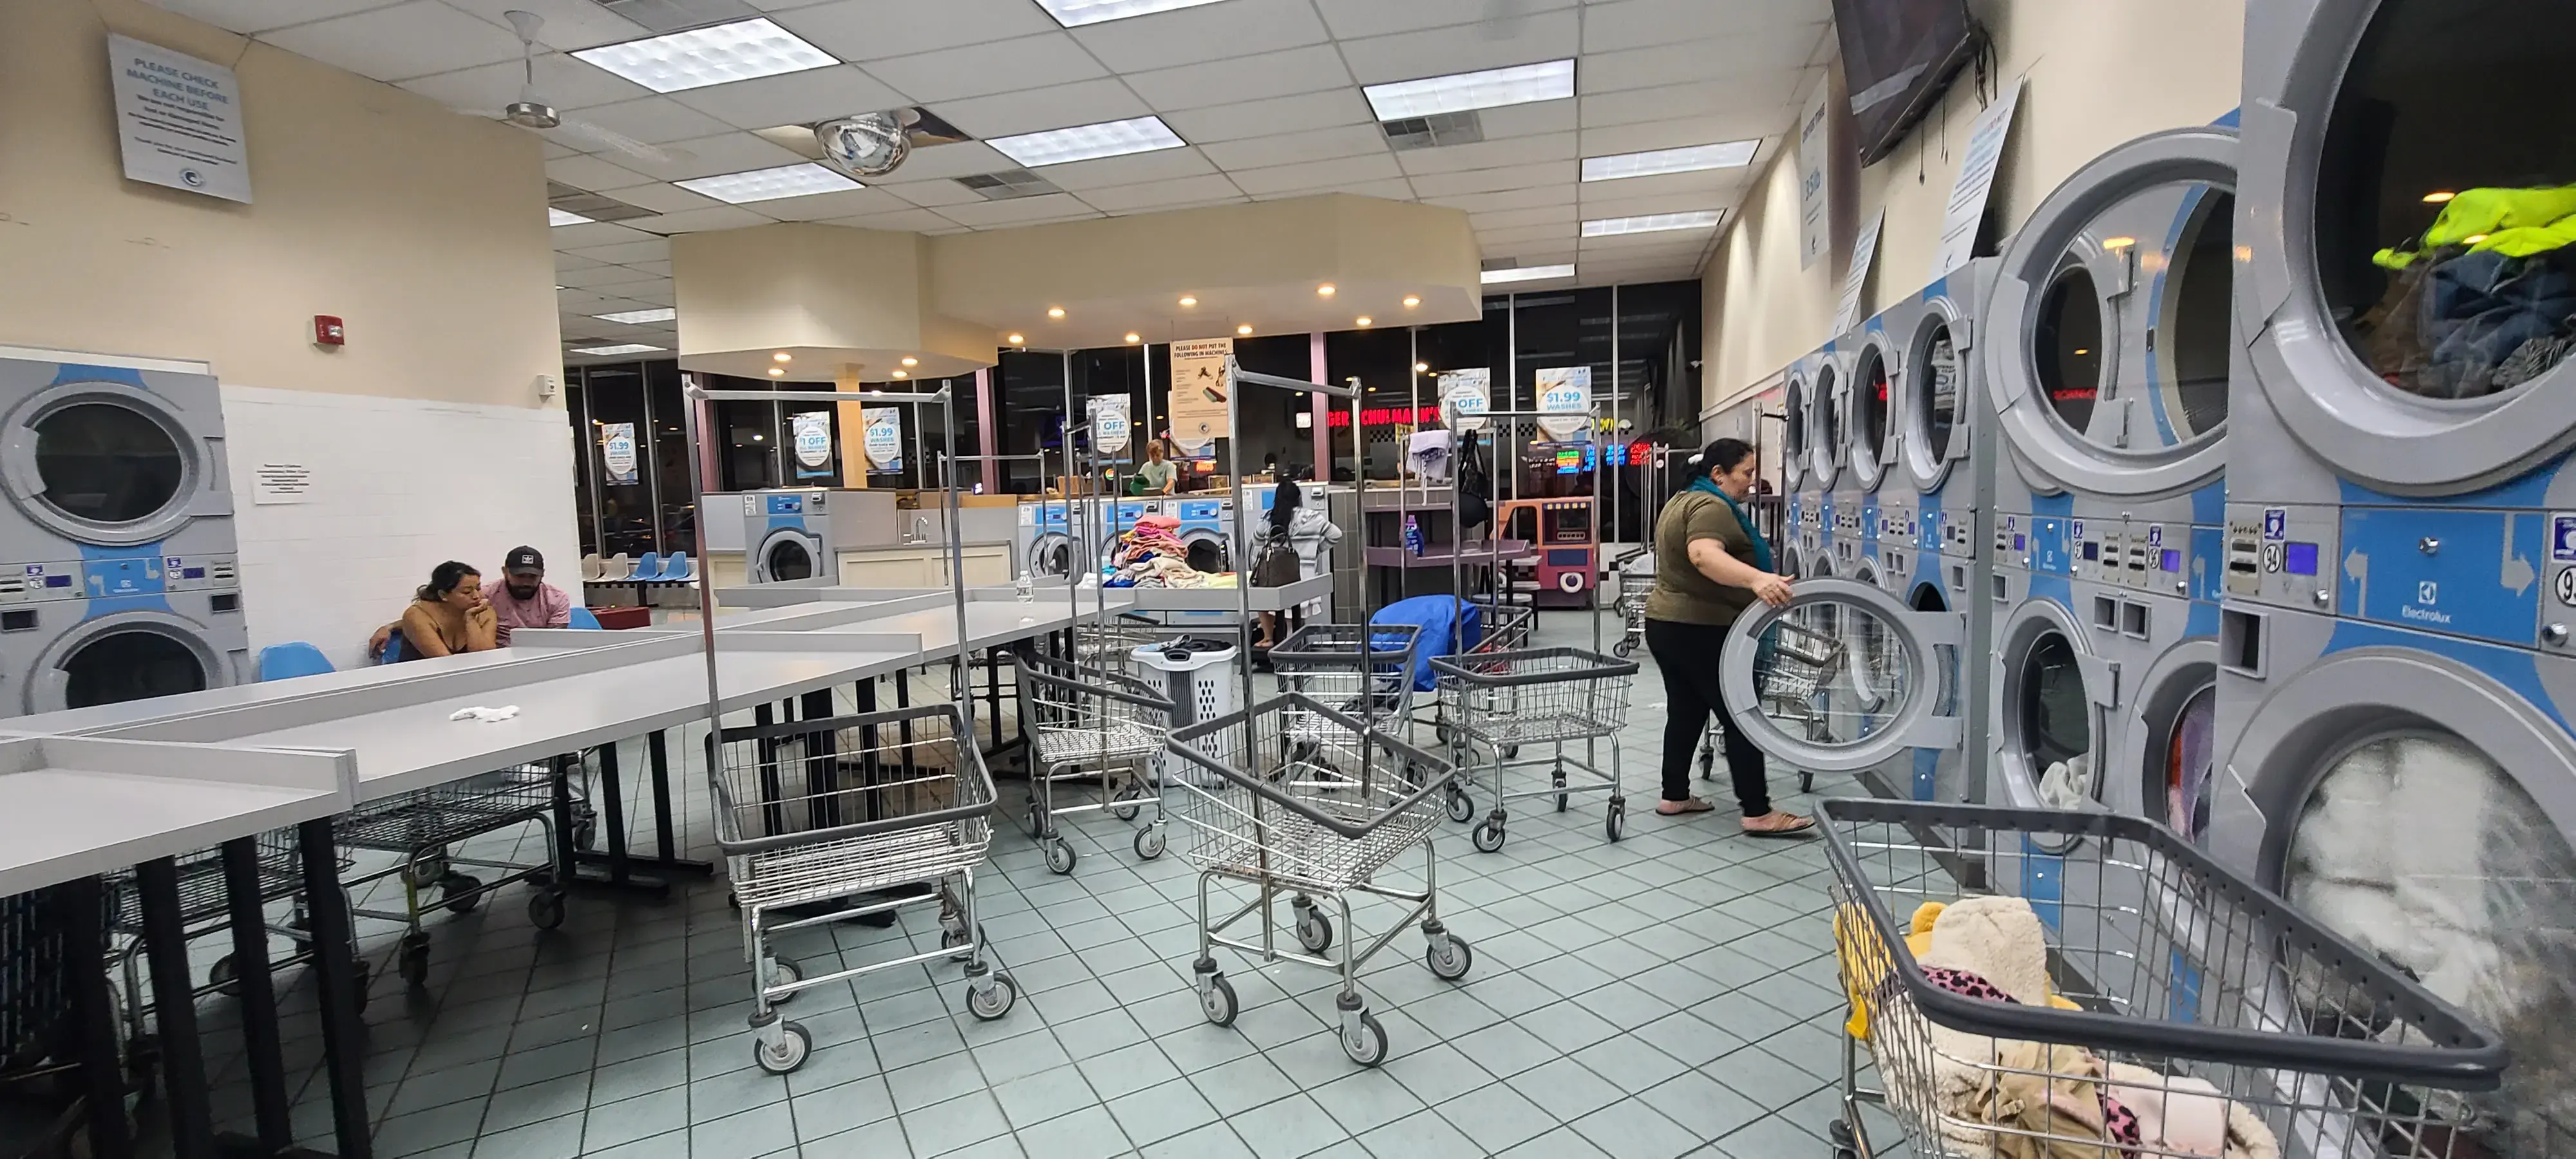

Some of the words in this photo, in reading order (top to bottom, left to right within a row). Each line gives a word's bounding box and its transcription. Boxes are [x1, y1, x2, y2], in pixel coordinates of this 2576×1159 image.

[135, 58, 178, 77] PLEASE
[181, 73, 218, 88] CHECK
[126, 69, 184, 91] MACHINE
[186, 86, 229, 104] BEFORE
[153, 88, 184, 103] EACH
[187, 99, 209, 111] USE
[1547, 391, 1580, 402] $1.99
[1458, 399, 1483, 408] OFF
[1327, 411, 1350, 426] GER
[1104, 421, 1124, 430] OFF
[870, 428, 893, 437] $1.99
[609, 442, 629, 450] $1.99
[2402, 605, 2452, 624] Electrolux
